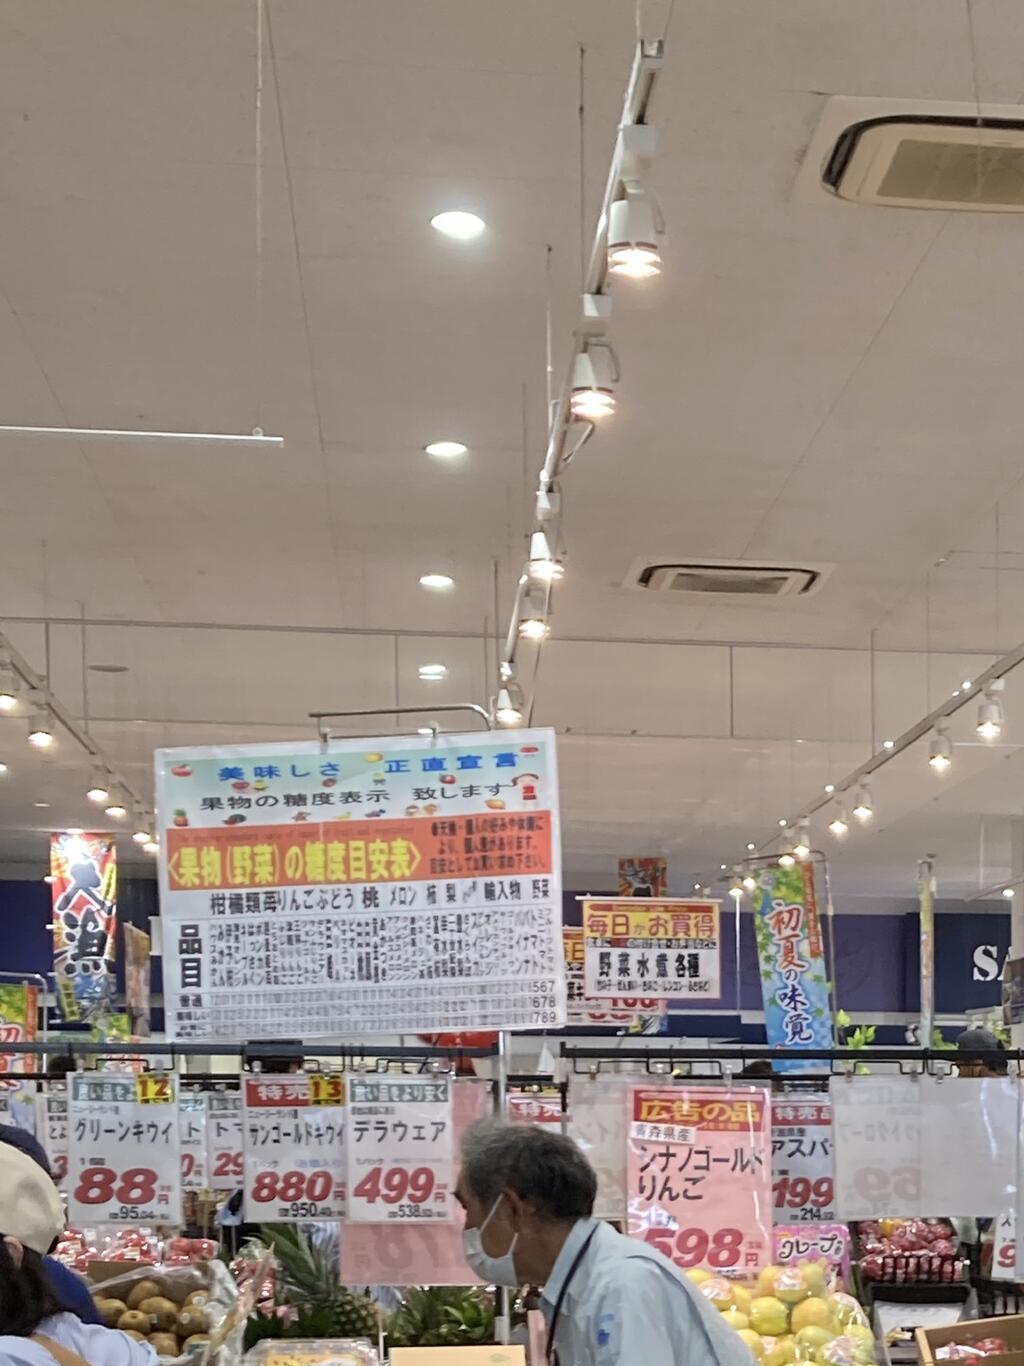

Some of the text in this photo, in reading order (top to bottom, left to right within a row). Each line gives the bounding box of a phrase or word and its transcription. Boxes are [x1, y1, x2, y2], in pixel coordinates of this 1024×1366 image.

[217, 752, 518, 781] 美味しさ 正直宣言
[200, 784, 505, 811] 果物の糖度表示 致します
[765, 901, 814, 1043] 初夏の味覚
[138, 1078, 171, 1098] 12
[257, 1080, 341, 1101] 特売 13
[640, 1100, 761, 1122] 広告の品
[74, 1117, 173, 1144] グリーンキウイ
[353, 1120, 447, 1143] デラウェア
[634, 1123, 692, 1142] 青森県産
[772, 1138, 834, 1159] アスパ
[73, 1166, 159, 1205] 88
[251, 1170, 333, 1203] 880
[353, 1166, 435, 1205] 499
[638, 1175, 706, 1201] りんご
[772, 1176, 834, 1209] 199
